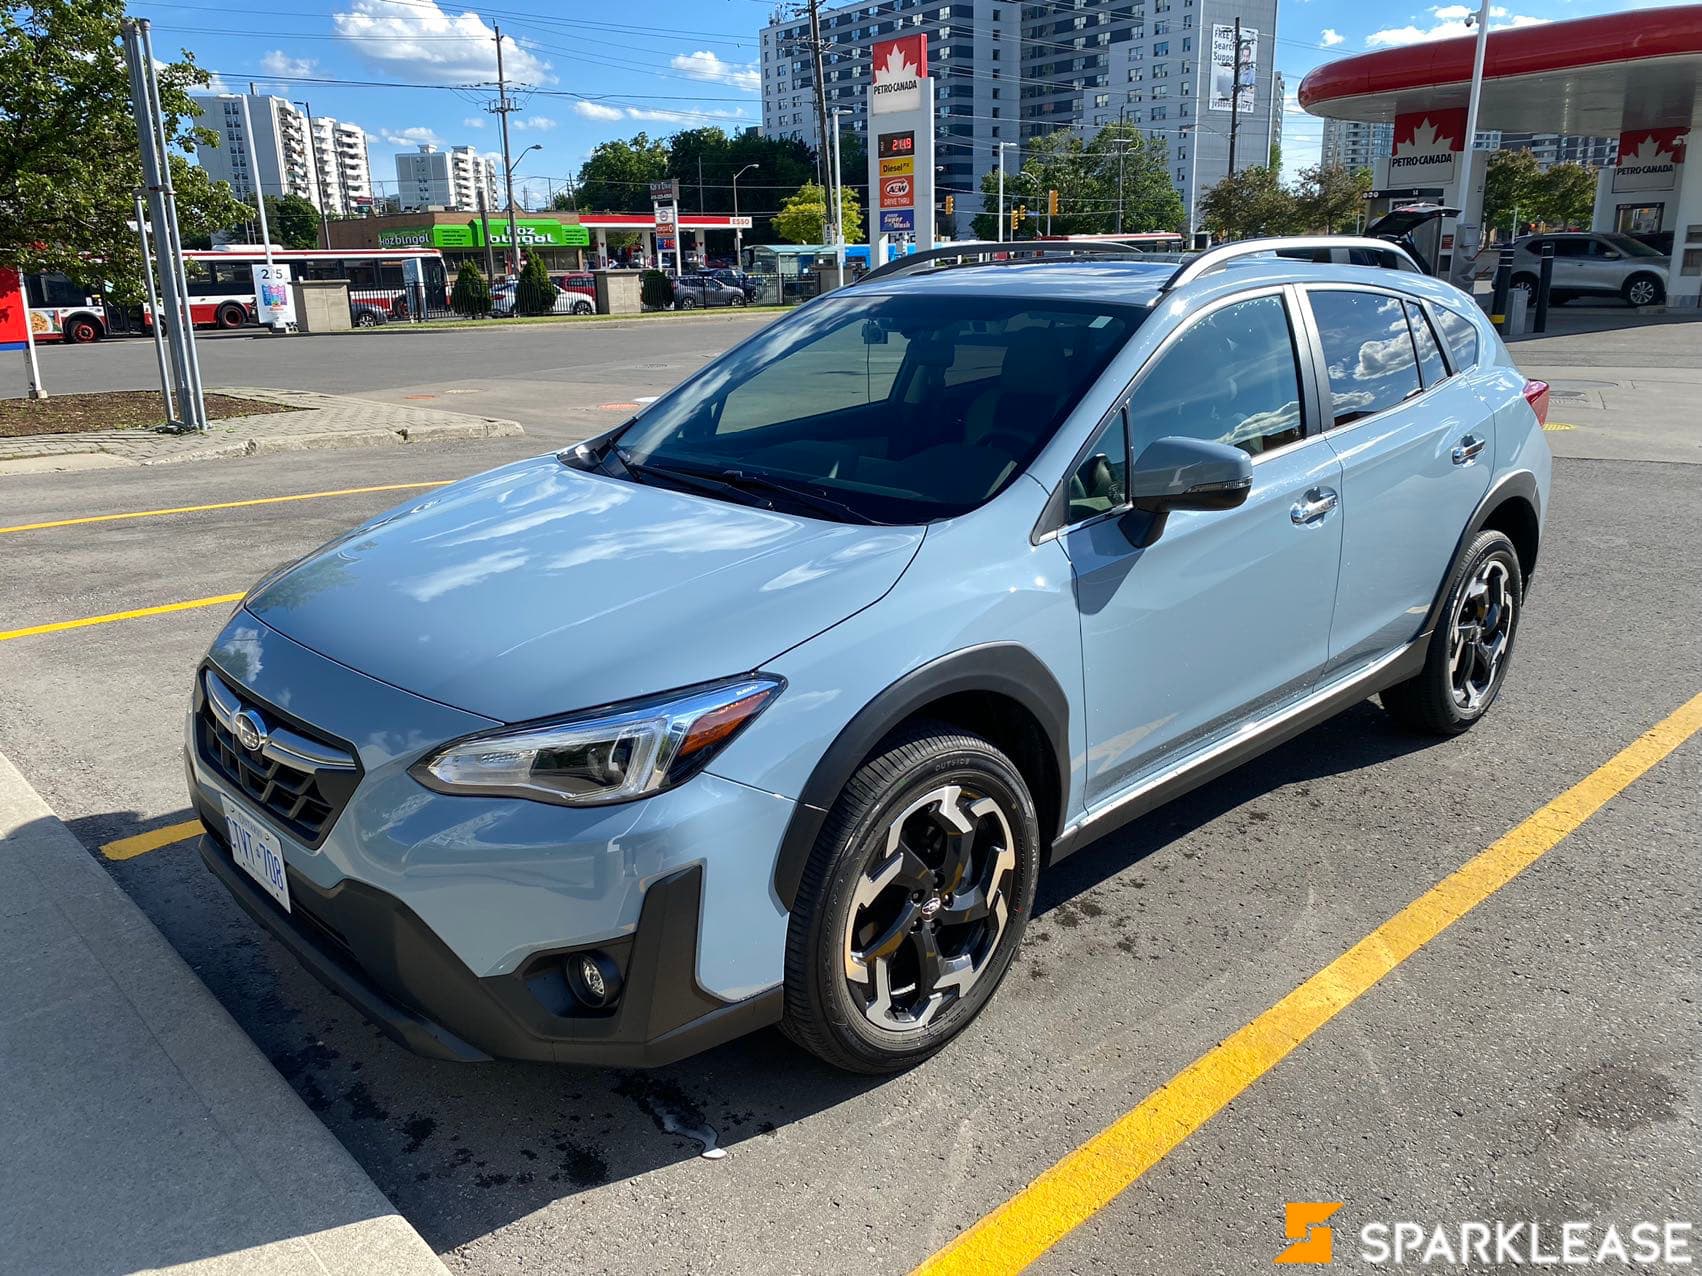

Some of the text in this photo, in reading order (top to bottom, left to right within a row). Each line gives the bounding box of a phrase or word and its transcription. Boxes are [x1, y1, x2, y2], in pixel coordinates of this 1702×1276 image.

[1392, 154, 1452, 167] PETRO-CANADA
[883, 163, 903, 172] Diesel
[888, 185, 907, 193] A&W
[884, 198, 897, 206] DRIVE
